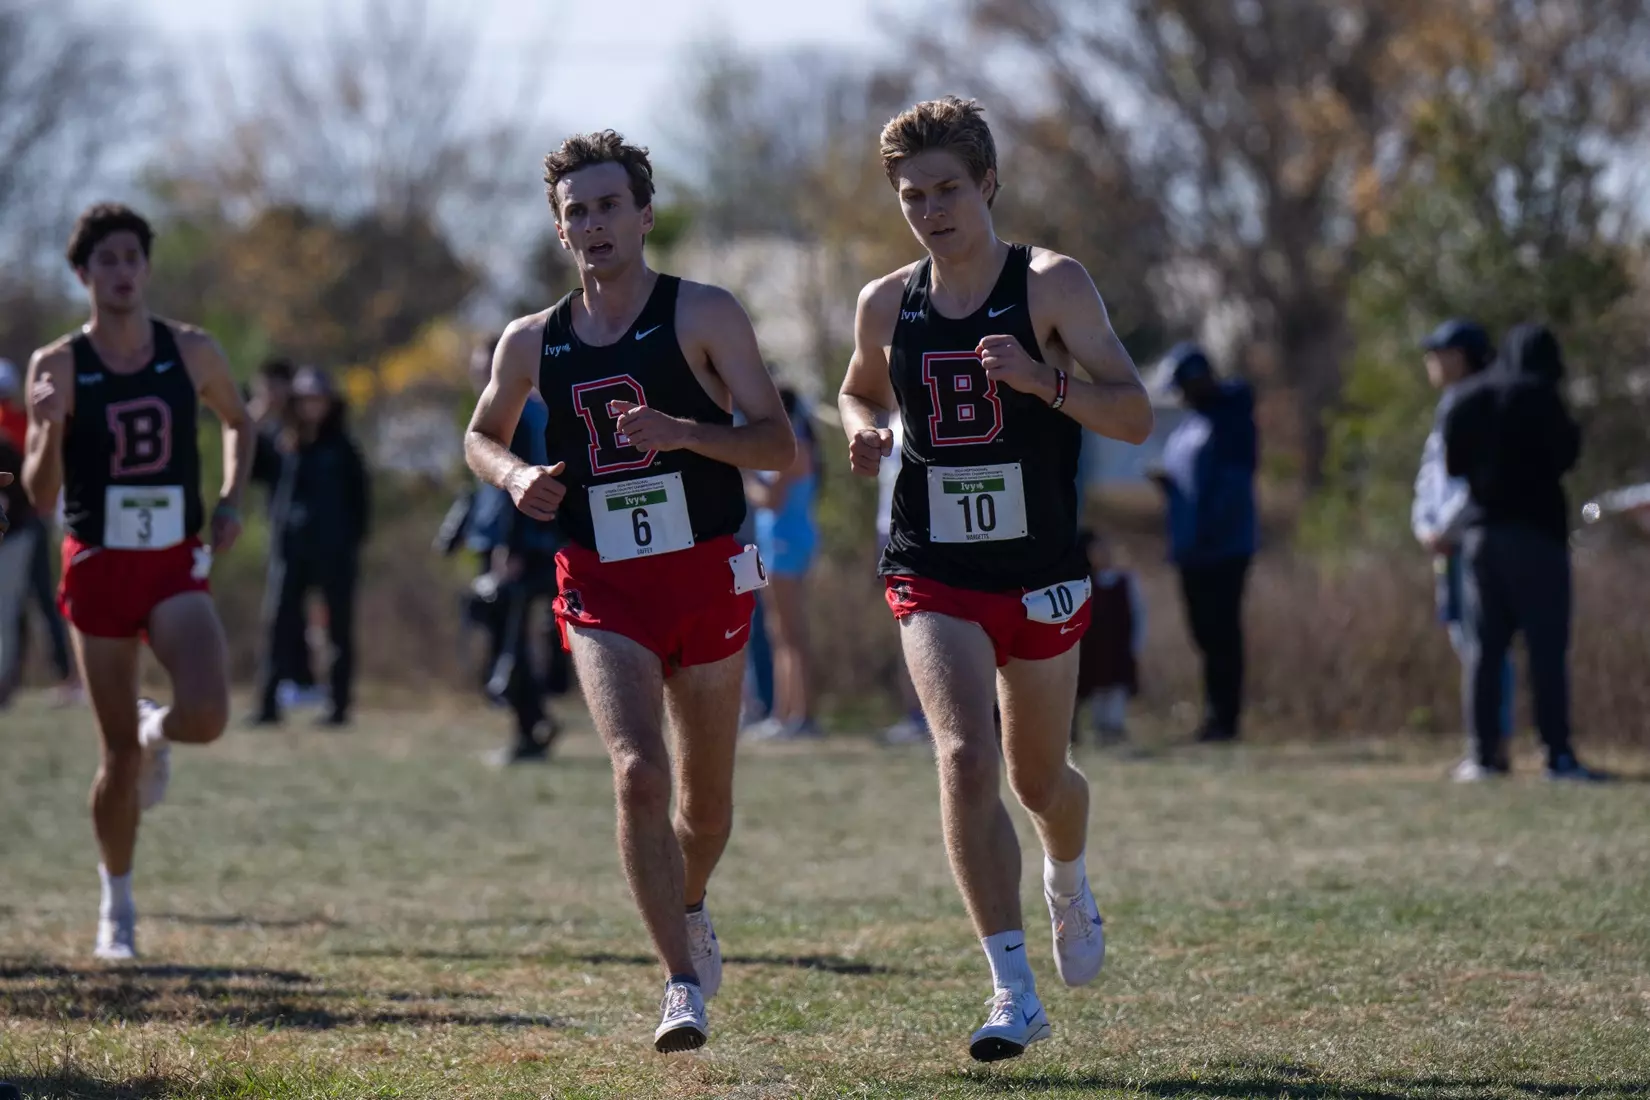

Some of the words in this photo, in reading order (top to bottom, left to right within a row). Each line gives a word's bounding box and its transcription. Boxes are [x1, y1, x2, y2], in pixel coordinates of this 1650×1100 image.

[901, 309, 918, 323] Ivy
[544, 344, 562, 357] Ivy
[922, 351, 1004, 448] B
[106, 396, 172, 479] B
[624, 495, 639, 506] Ivy
[960, 482, 976, 492] Ivy
[137, 508, 152, 540] 3
[632, 507, 652, 547] 6
[957, 493, 996, 533] 10
[1044, 585, 1073, 619] 10
